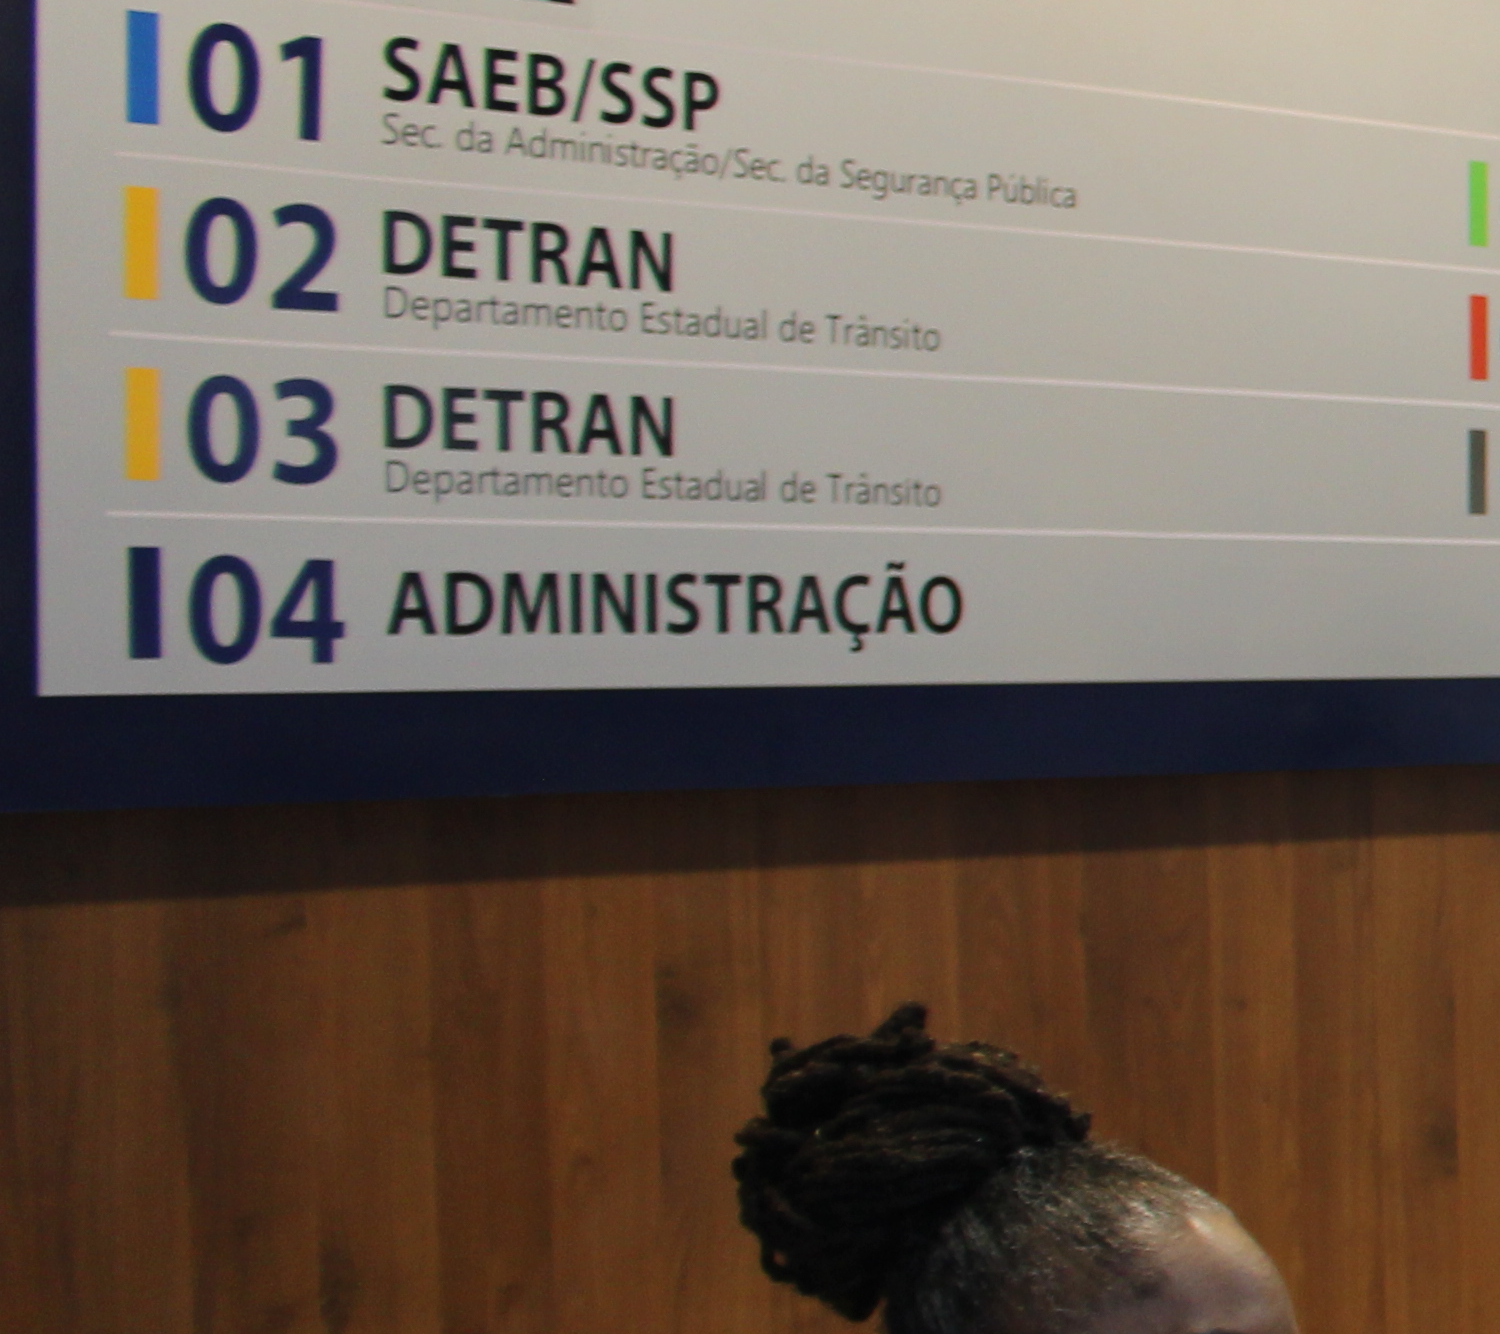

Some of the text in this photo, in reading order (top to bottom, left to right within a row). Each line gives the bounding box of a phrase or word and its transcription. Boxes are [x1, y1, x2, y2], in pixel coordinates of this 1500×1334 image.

[186, 22, 325, 141] 01
[381, 36, 719, 131] SAEB/SSP
[381, 113, 1078, 209] Sec. da Administração/Sec. da Segurança Pública
[183, 198, 338, 312] 02
[382, 210, 675, 292] DETRAN
[384, 285, 941, 353] Departamento Estadual de Trânsito
[185, 374, 338, 483] 03
[382, 384, 675, 456] DETRAN
[385, 460, 942, 508] Departamento Estadual de Trânsito
[187, 552, 345, 664] 04
[386, 561, 963, 652] ADMINISTRAÇÃO
